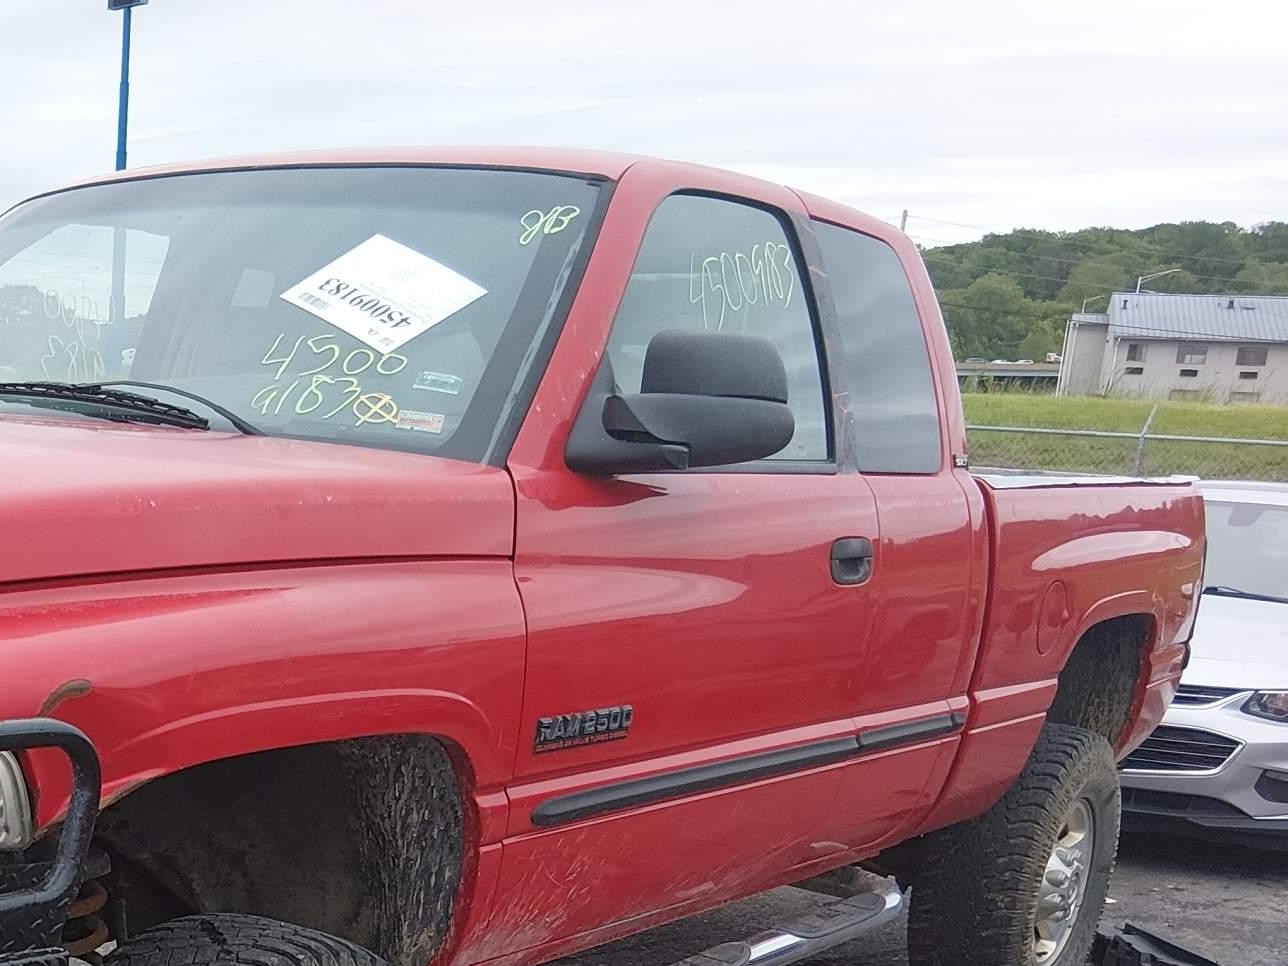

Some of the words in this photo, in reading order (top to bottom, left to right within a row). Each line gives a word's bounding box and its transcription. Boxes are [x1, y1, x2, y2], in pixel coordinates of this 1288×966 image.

[318, 277, 412, 329] 45009183
[689, 241, 794, 330] 45009183
[261, 333, 408, 380] 4500
[536, 712, 583, 743] RAM
[583, 704, 634, 734] 2500
